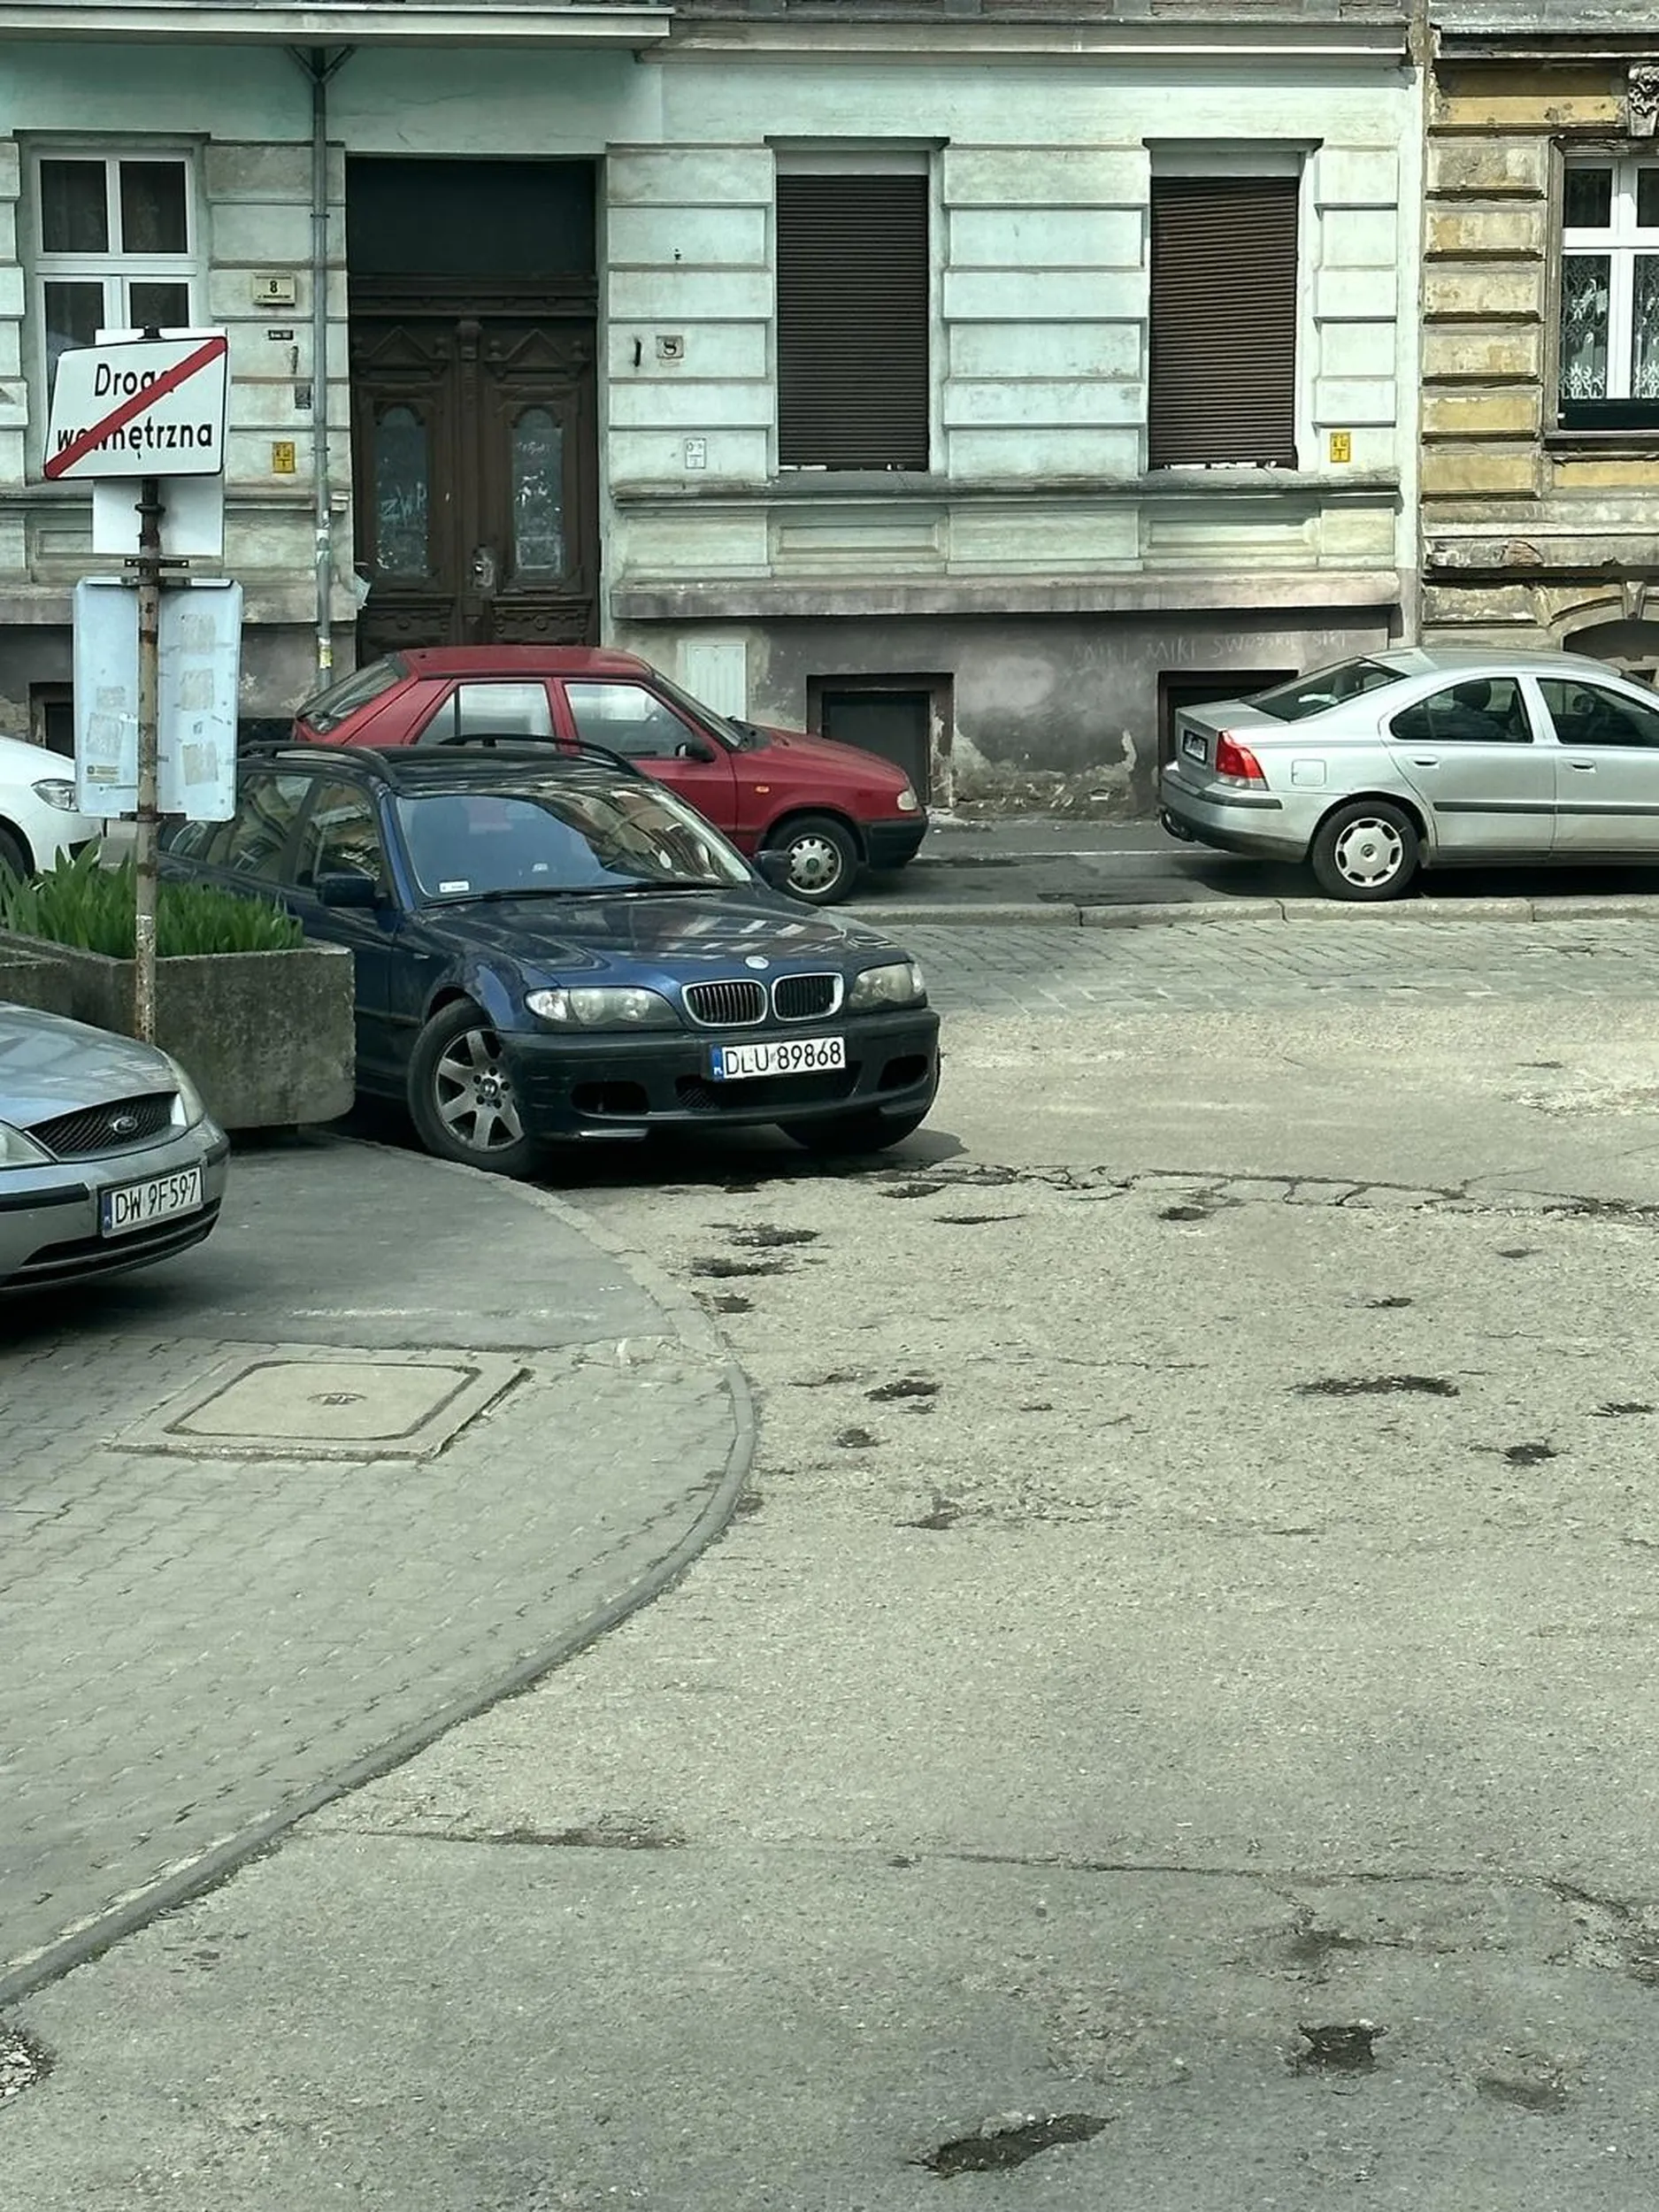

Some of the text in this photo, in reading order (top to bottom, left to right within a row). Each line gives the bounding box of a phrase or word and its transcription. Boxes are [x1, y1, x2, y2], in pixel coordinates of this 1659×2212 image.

[270, 280, 278, 294] 8
[95, 363, 174, 396] Drog
[726, 1041, 841, 1075] DLU 89868
[116, 1187, 141, 1224] DW
[149, 1171, 196, 1216] 9F597
